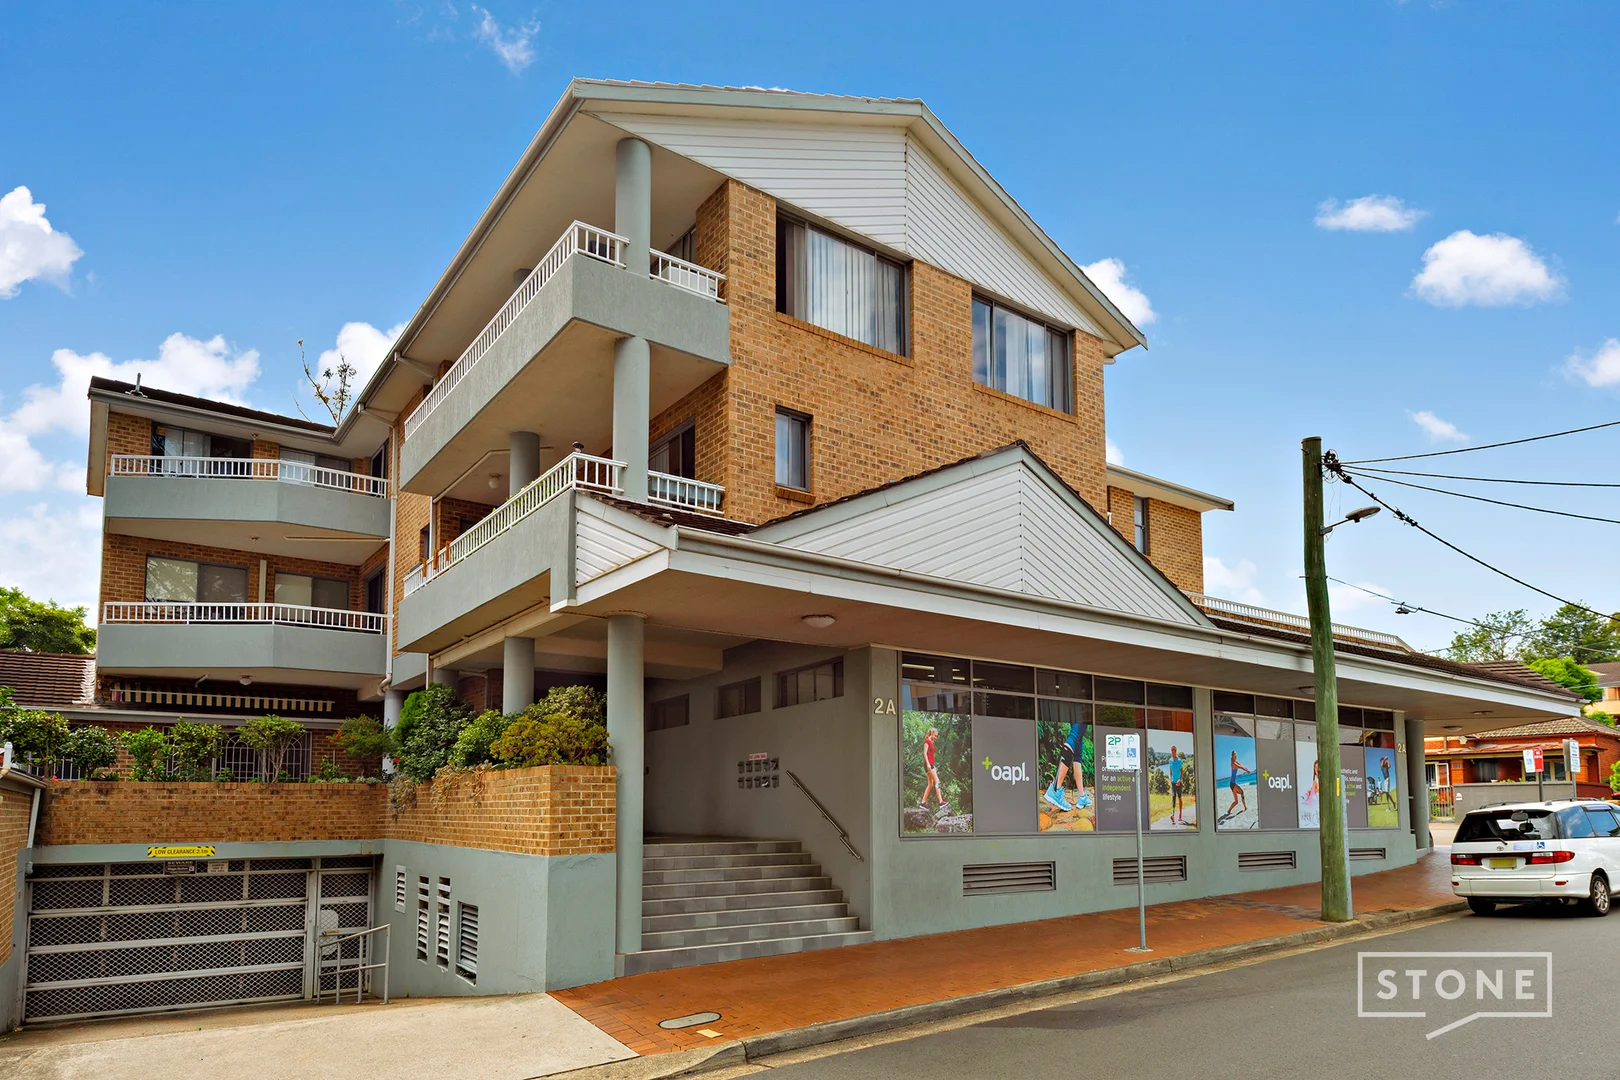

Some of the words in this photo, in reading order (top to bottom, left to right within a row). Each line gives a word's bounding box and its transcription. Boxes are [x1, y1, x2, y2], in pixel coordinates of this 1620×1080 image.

[874, 697, 896, 715] 2A
[1108, 736, 1121, 746] 2P
[991, 762, 1030, 786] oapl.
[1268, 774, 1292, 792] oapl.
[1102, 794, 1122, 802] lifestyle
